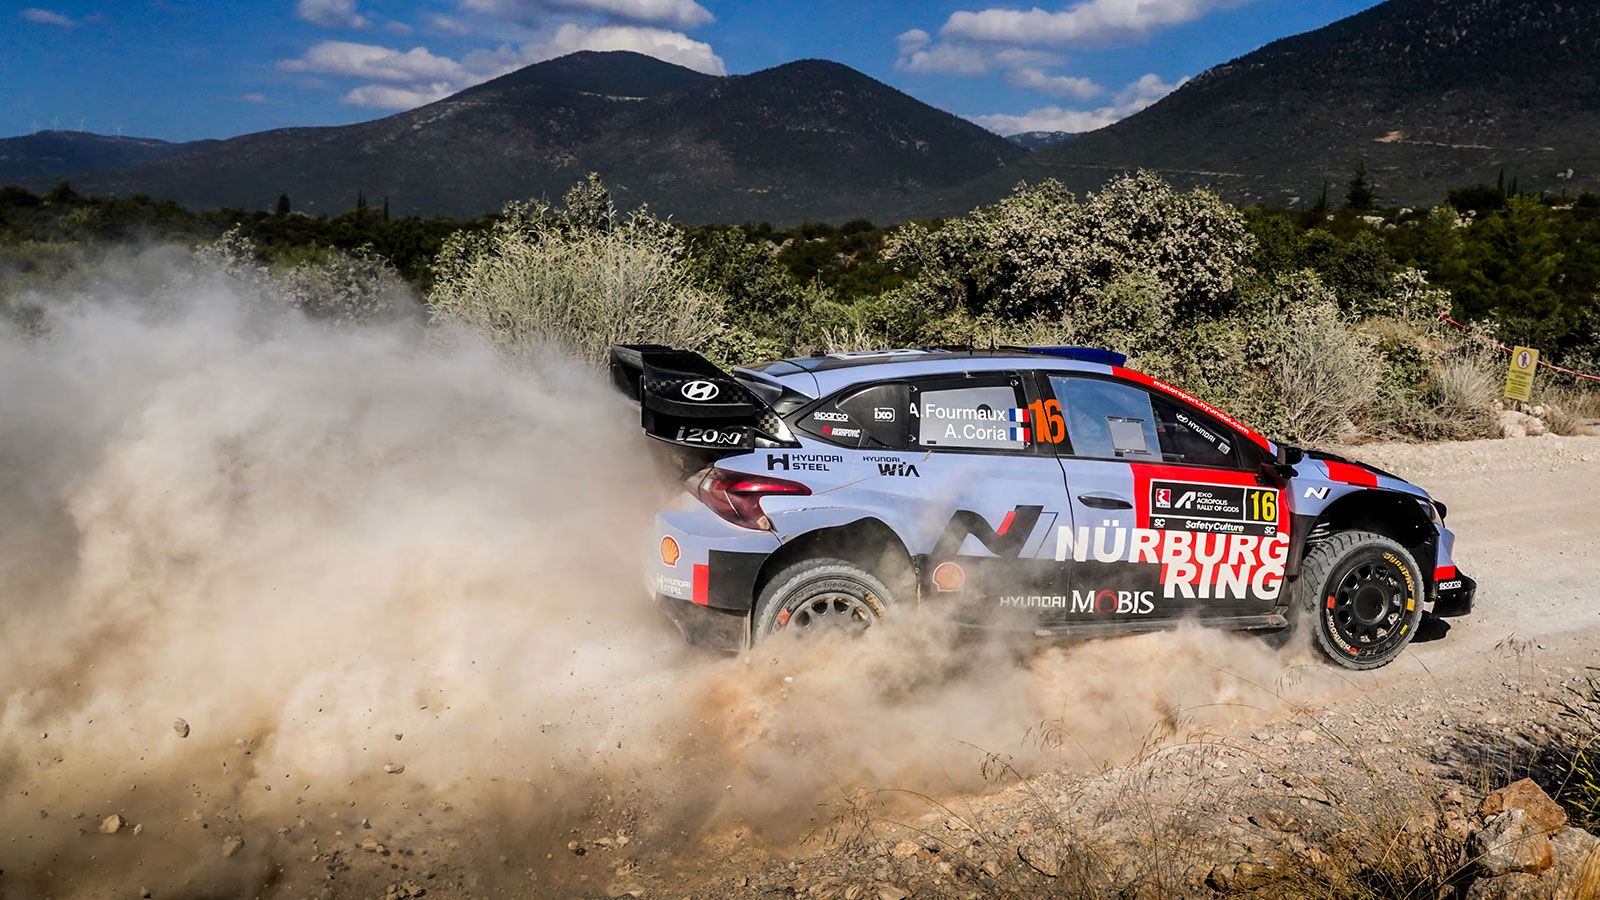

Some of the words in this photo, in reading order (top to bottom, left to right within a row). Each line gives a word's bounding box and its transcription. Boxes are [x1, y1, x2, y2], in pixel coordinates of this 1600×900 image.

[1153, 380, 1250, 434] motorsport.hyundai.com
[1028, 398, 1066, 444] 16
[1187, 420, 1216, 443] HYUNDAI
[792, 454, 843, 463] HYUNDAI
[792, 462, 830, 472] STEEL
[863, 455, 900, 463] HYUNDAI
[1196, 498, 1228, 506] ACROPOLIS
[1250, 490, 1276, 522] 16
[1153, 518, 1165, 527] SC
[1185, 520, 1244, 531] SafetyCulture
[1264, 526, 1276, 534] SC
[1055, 519, 1290, 566] NÜRBURG
[663, 577, 691, 588] HYUNDAI
[1163, 562, 1285, 600] RING
[1000, 594, 1066, 608] HYUNDAI
[1070, 588, 1154, 615] MOBIS
